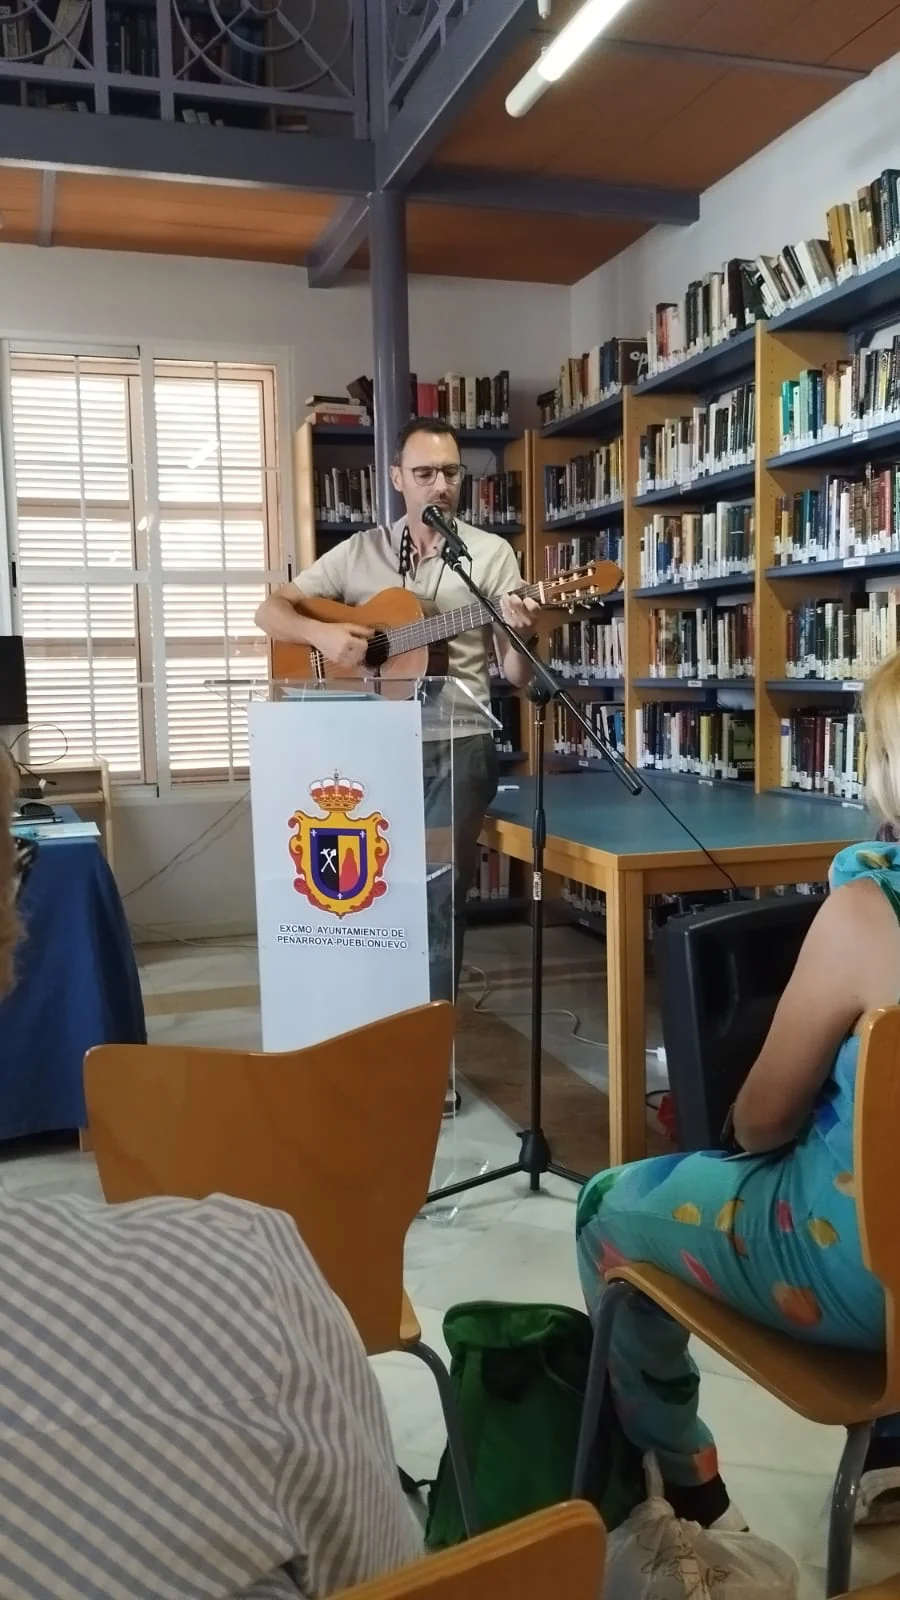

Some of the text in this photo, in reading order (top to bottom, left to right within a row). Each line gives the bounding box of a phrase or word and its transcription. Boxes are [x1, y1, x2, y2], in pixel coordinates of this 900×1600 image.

[317, 926, 389, 937] AYUNTAMIENTO
[391, 929, 405, 938] DE
[277, 935, 408, 949] PEÑARROYA-PUEBLONUEVO
